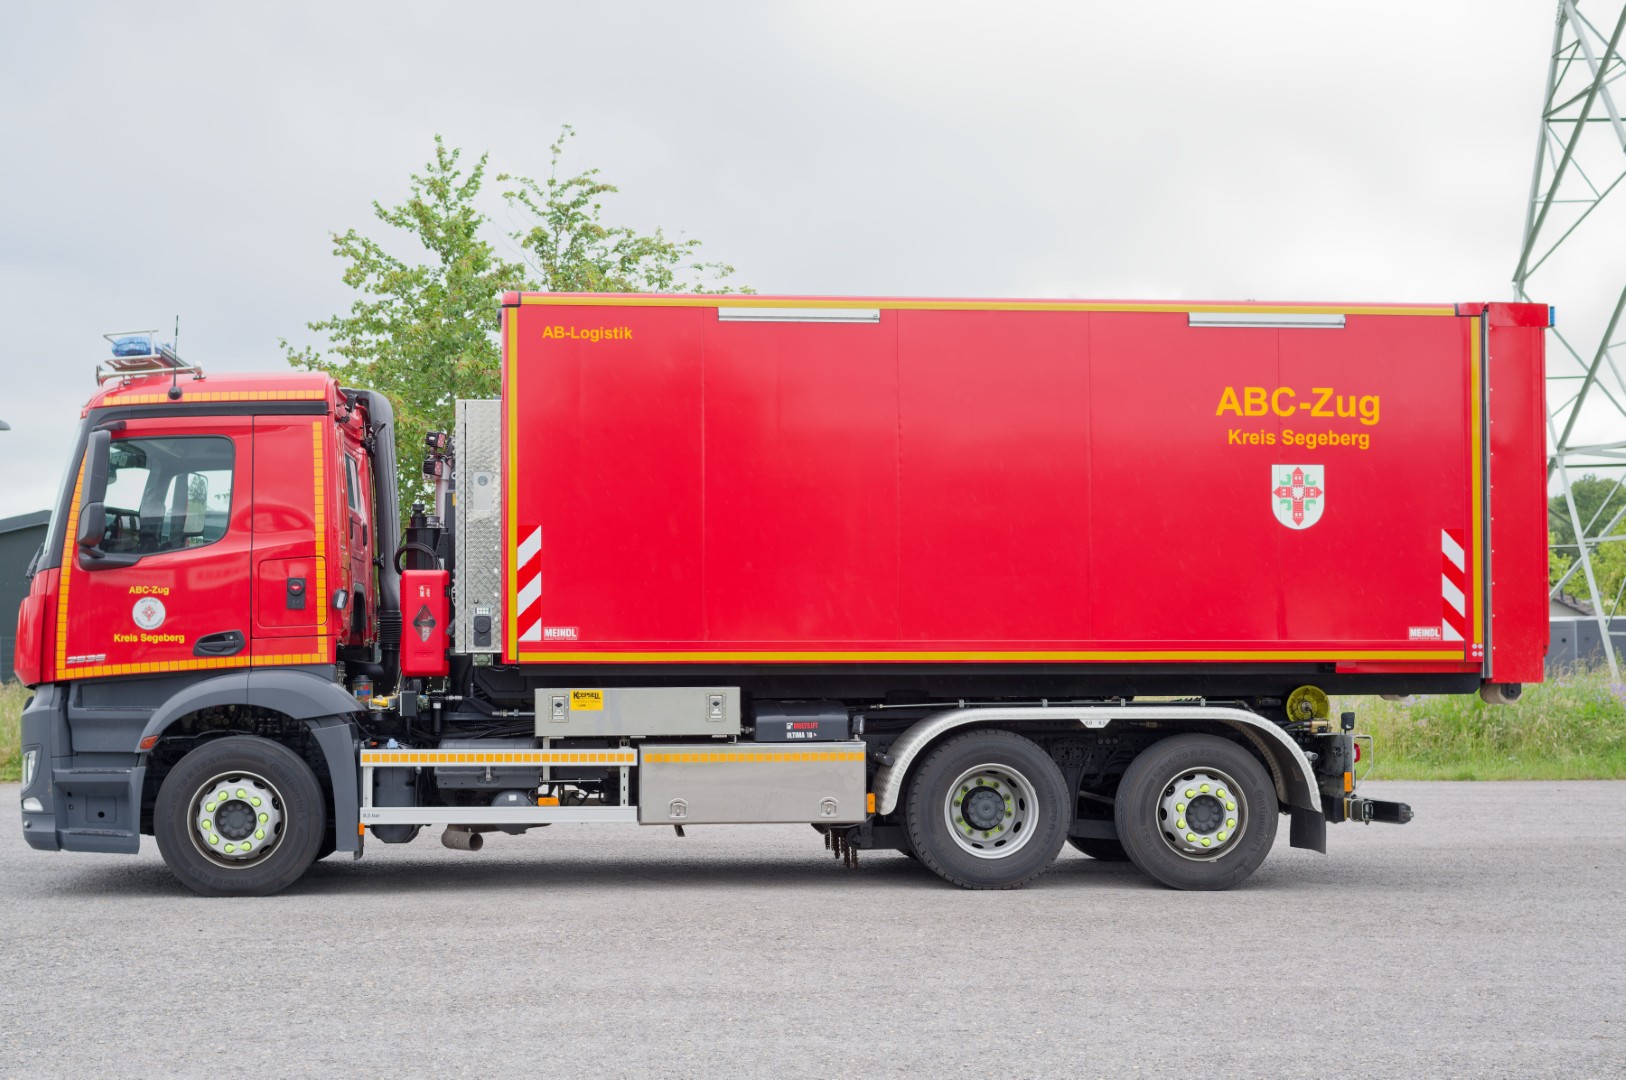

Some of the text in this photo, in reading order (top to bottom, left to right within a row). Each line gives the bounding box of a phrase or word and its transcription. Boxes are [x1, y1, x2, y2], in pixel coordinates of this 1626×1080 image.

[542, 326, 633, 342] AB-Logistik
[1216, 386, 1381, 426] ABC-Zug
[1227, 429, 1371, 449] Kreis Segeberg
[128, 585, 170, 596] ABC-Zug
[544, 628, 577, 637] MEINDL
[1409, 628, 1441, 637] MEINDL
[113, 633, 185, 645] Kreis Segeberg
